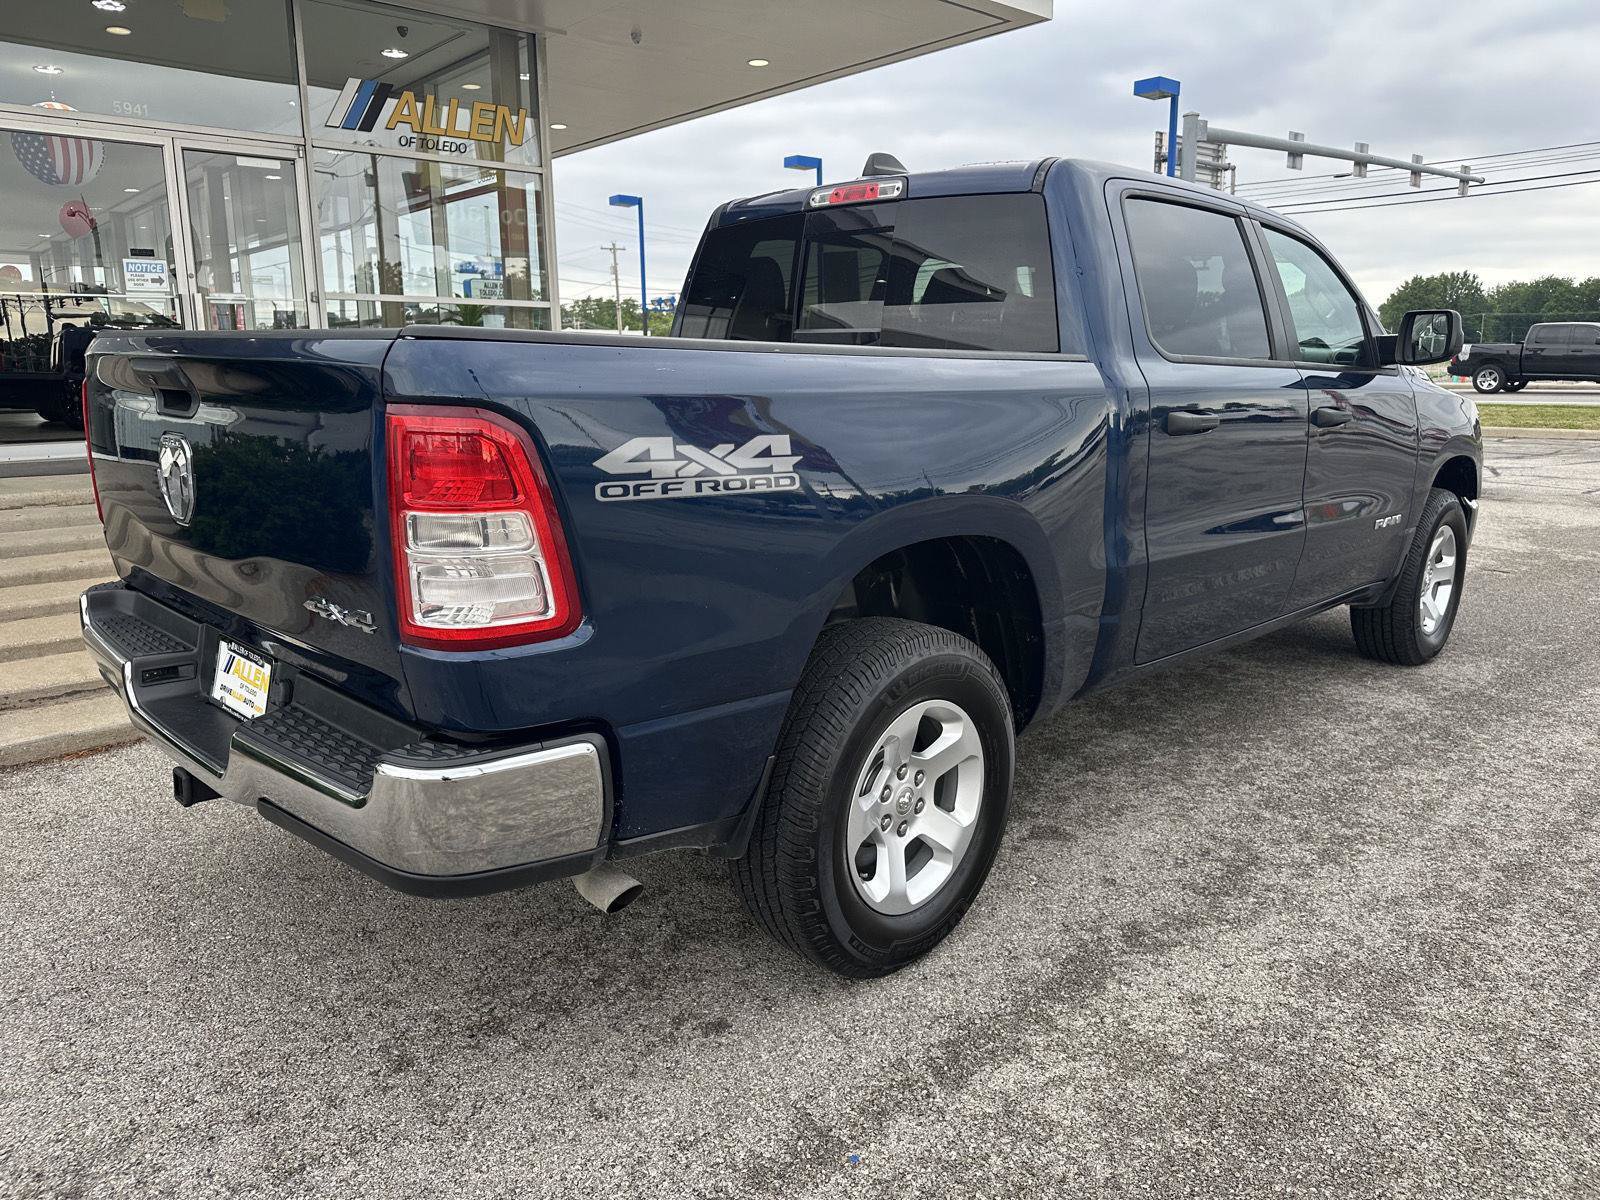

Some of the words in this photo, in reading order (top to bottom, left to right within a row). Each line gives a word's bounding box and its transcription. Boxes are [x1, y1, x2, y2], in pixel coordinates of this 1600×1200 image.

[112, 101, 148, 117] 5941
[386, 89, 527, 146] ALLEN
[399, 136, 416, 147] OF
[418, 138, 467, 154] TOLEDO
[128, 263, 163, 272] NOTICE
[599, 481, 685, 499] OFF
[694, 475, 798, 493] ROAD
[1374, 513, 1402, 530] RAM
[233, 658, 270, 694] ALLEN
[245, 685, 258, 698] TOLEDO
